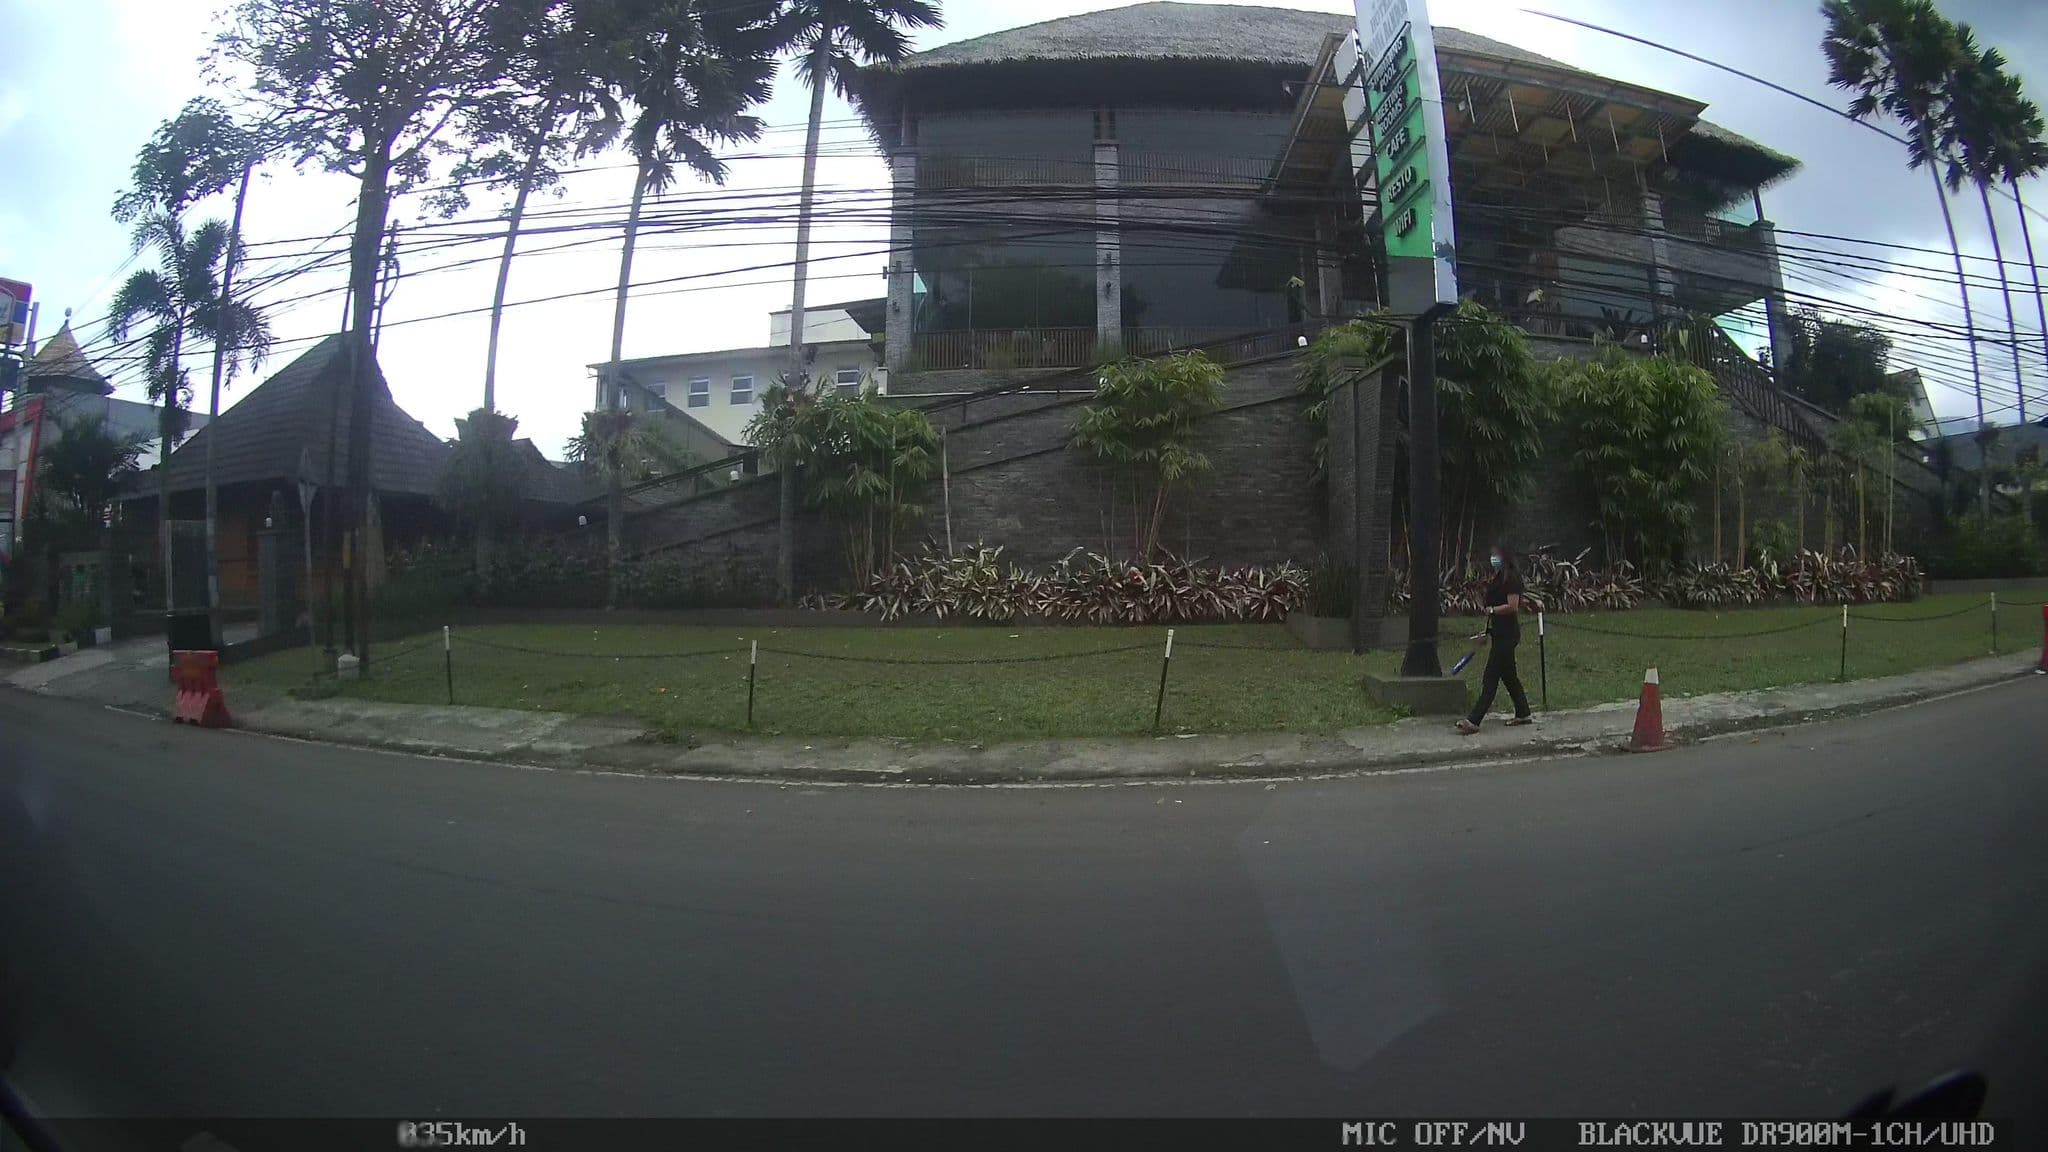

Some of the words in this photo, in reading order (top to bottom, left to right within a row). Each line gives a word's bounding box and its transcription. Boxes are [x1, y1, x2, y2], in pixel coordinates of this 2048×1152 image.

[1380, 63, 1398, 92] POOL
[1374, 82, 1403, 120] MEETING
[1380, 97, 1403, 135] ROOMS
[1385, 127, 1406, 157] CAFE
[1386, 167, 1412, 202] RESTO
[1393, 207, 1411, 237] WIFI
